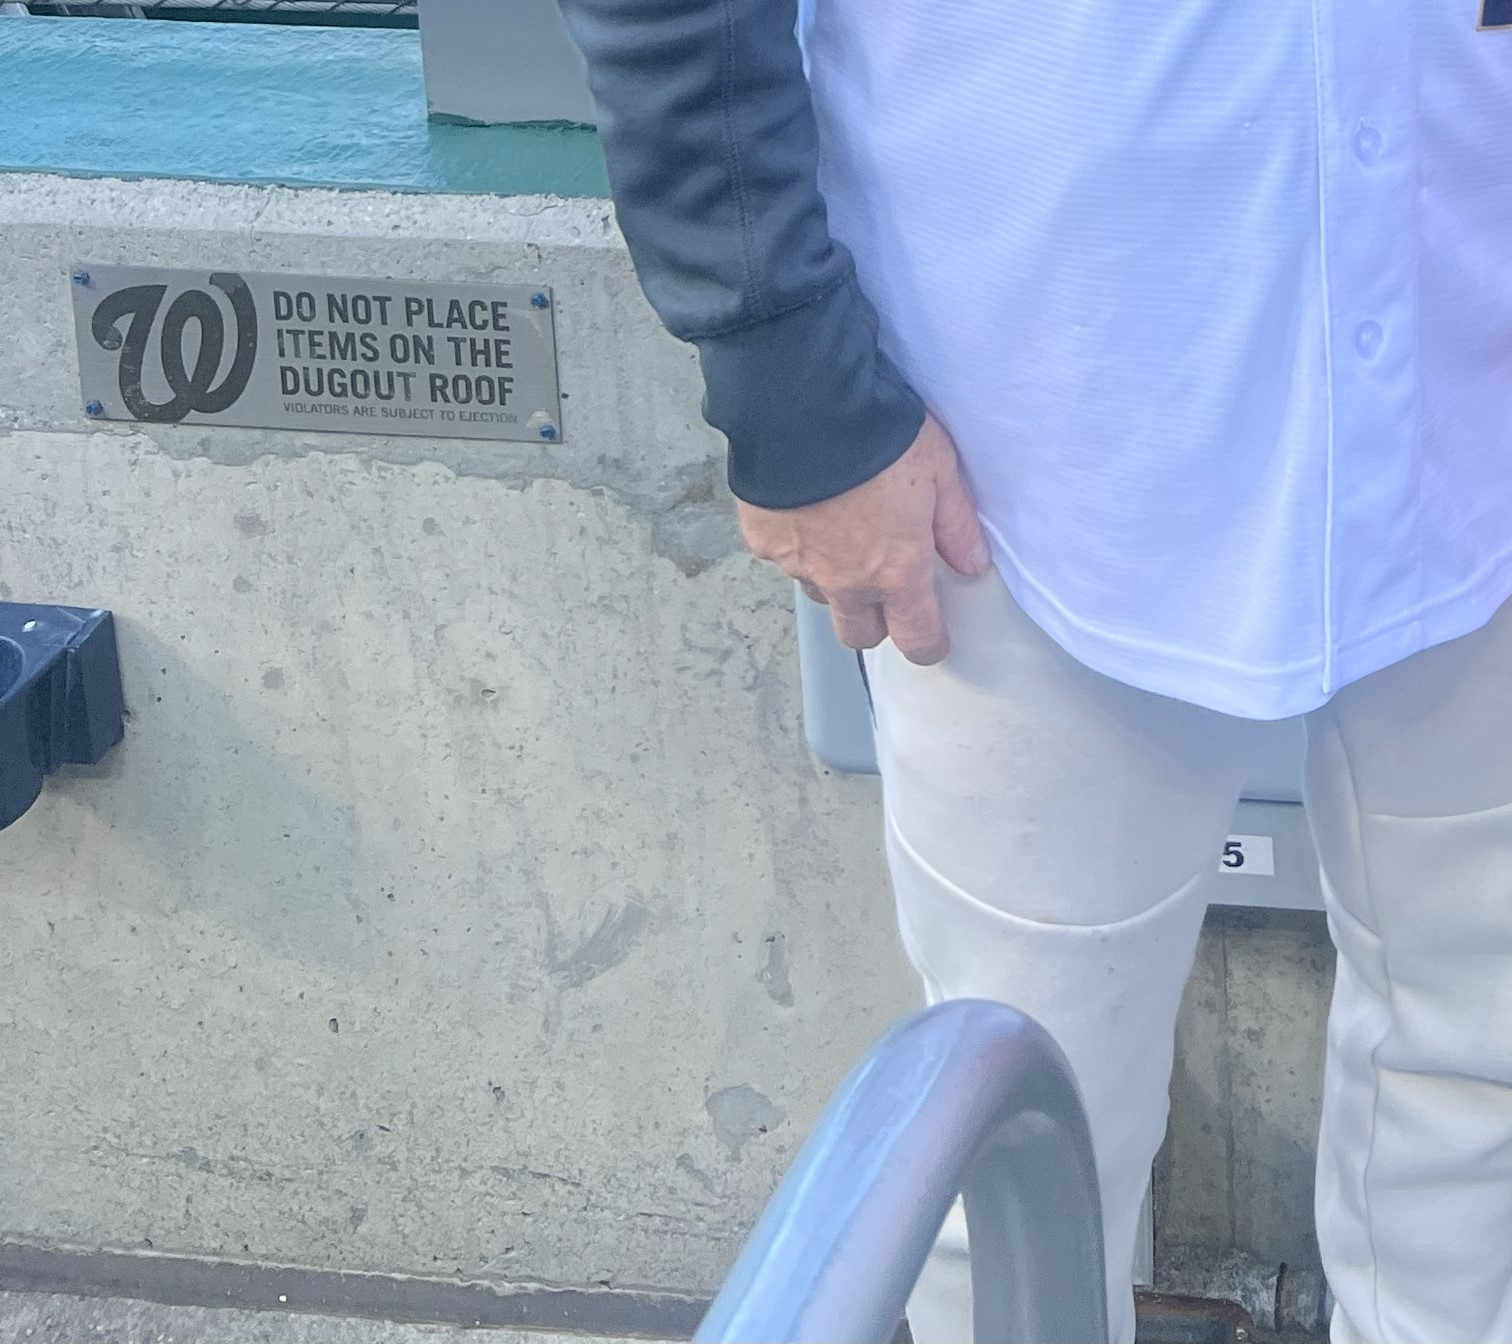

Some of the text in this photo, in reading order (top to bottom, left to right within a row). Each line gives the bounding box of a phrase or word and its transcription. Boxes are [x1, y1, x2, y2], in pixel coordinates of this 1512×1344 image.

[273, 290, 511, 332] DO NOT PLACE
[276, 328, 514, 369] ITEMS ON THE
[279, 365, 515, 407] DUGOUT ROOF
[283, 402, 518, 425] VIOLATORS ARE SUBJECT TO EJECTION
[1222, 841, 1245, 868] 5
